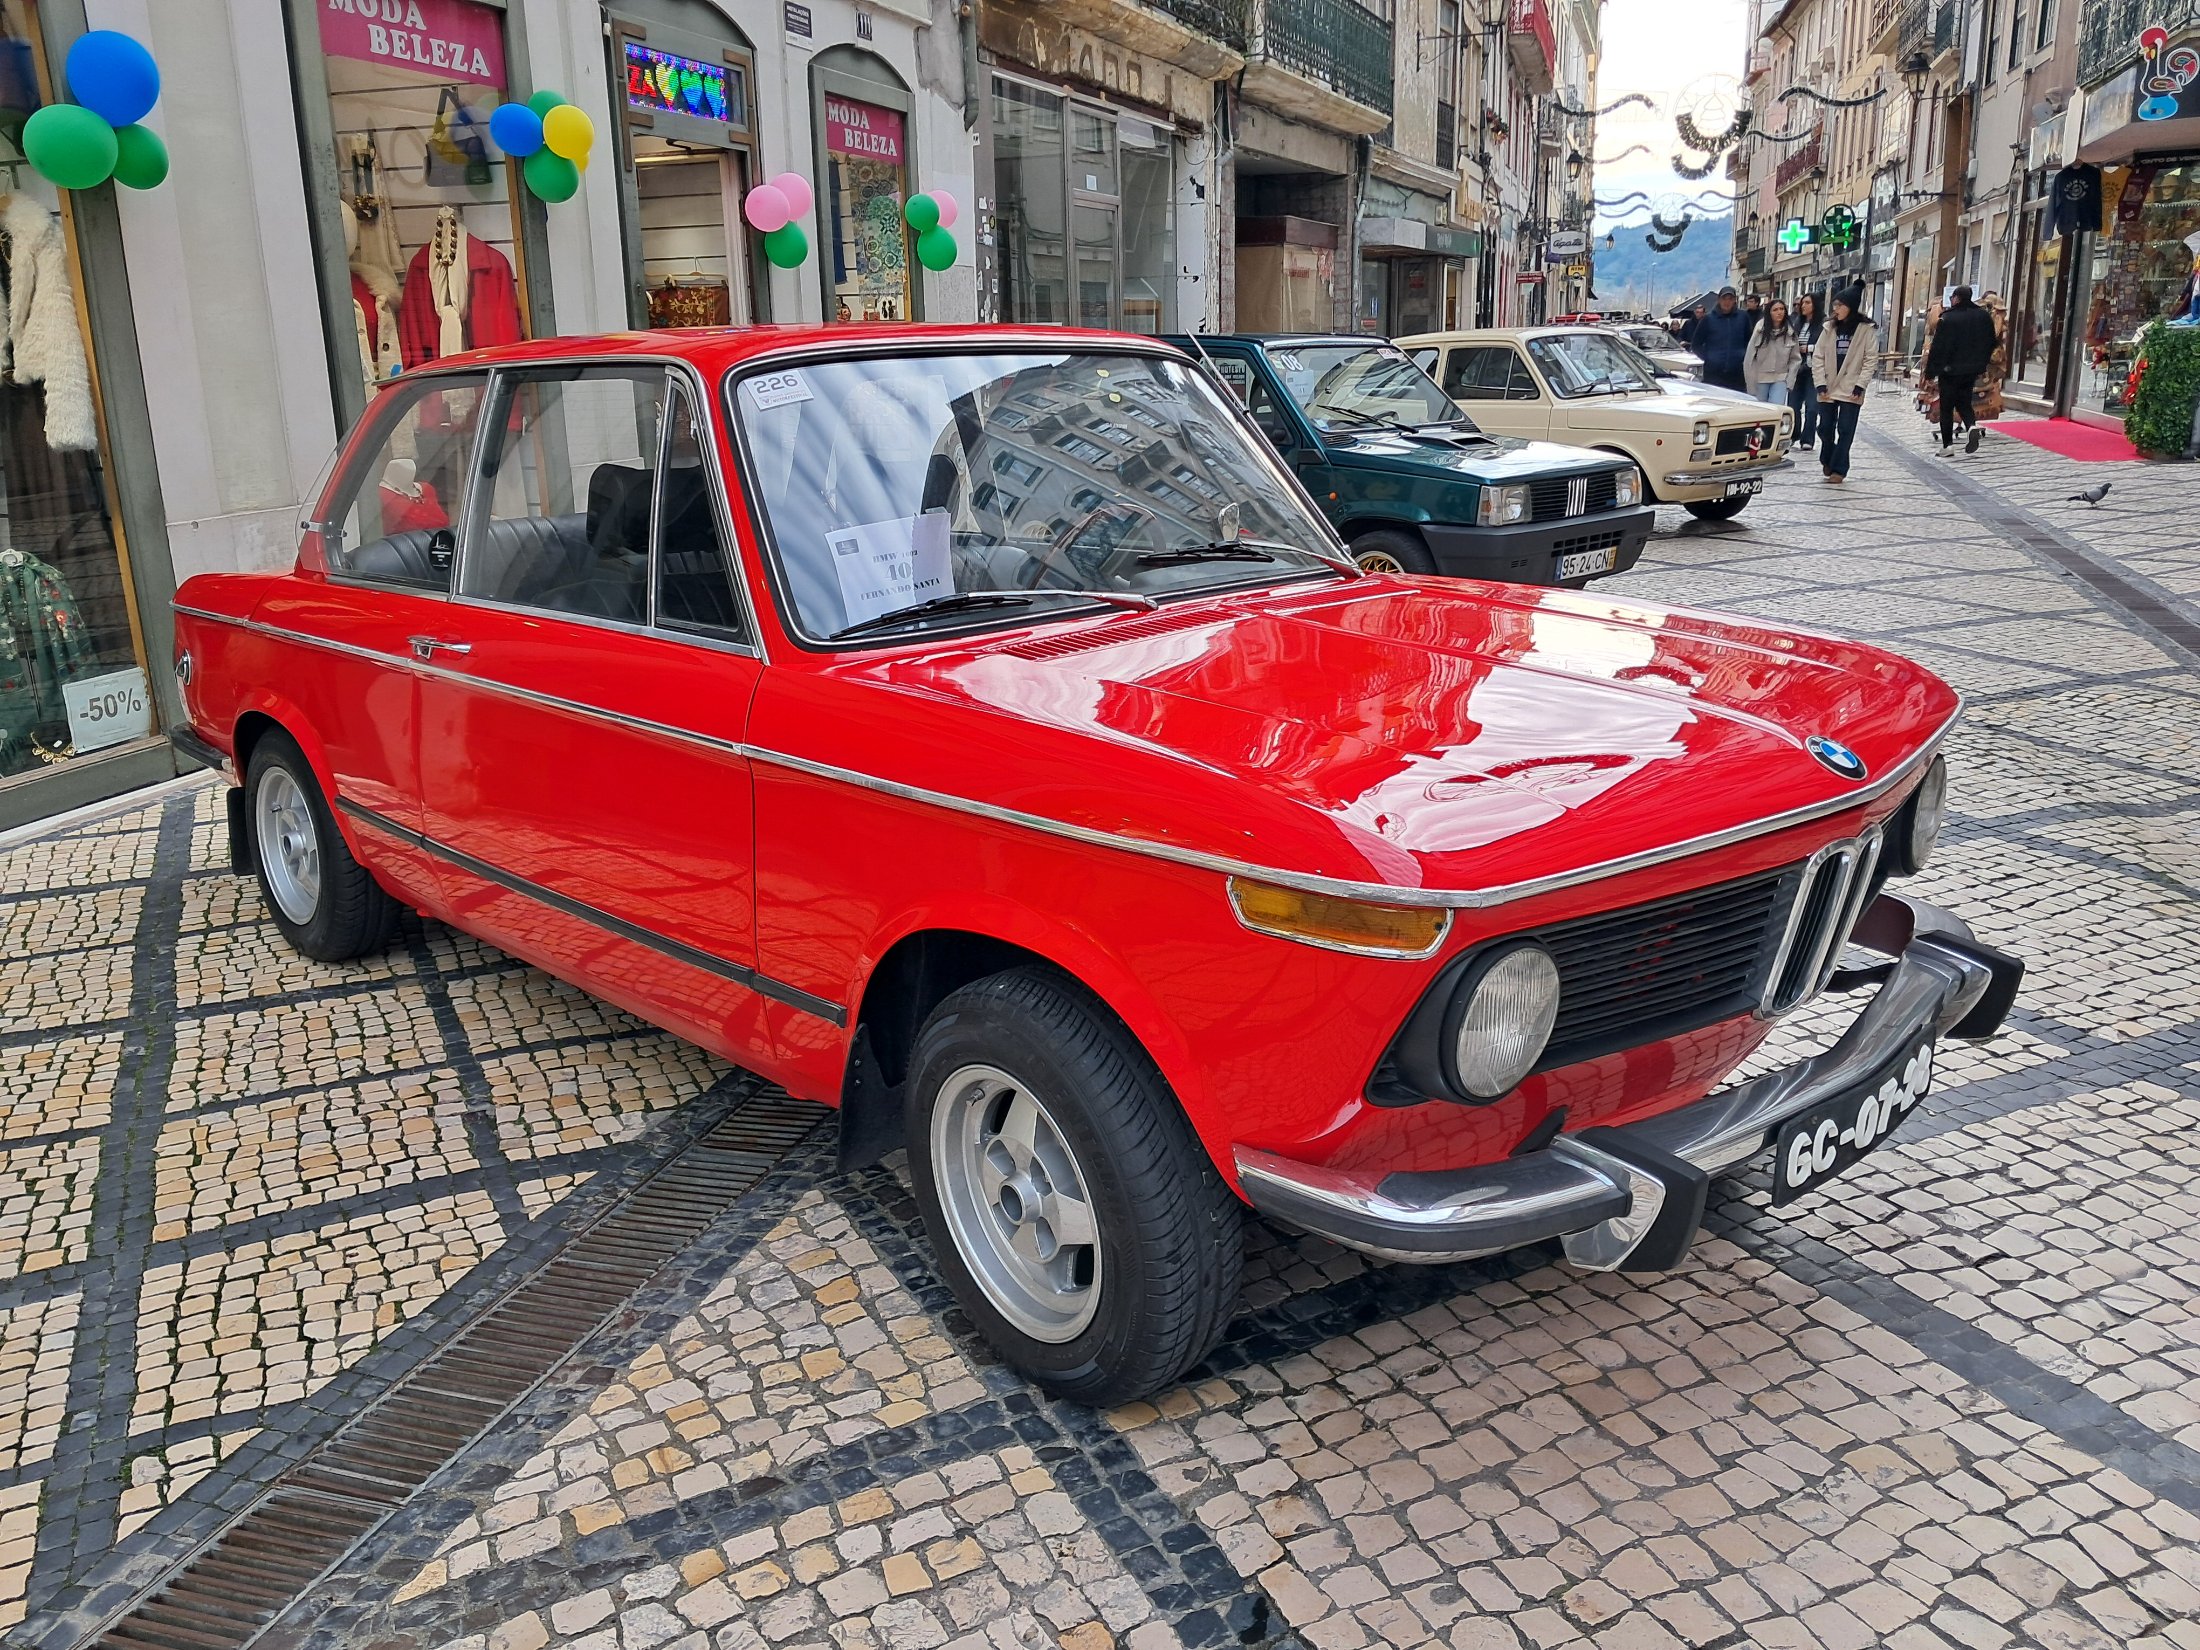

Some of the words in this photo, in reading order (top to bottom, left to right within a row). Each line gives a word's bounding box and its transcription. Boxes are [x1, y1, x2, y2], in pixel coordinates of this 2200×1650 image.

[328, 0, 427, 30] MODA
[367, 24, 491, 77] BELEZA
[827, 101, 870, 130] MODA
[844, 127, 898, 157] BELEZA
[1281, 354, 1304, 371] 08
[753, 374, 798, 394] 226
[873, 551, 898, 564] BMW
[860, 584, 912, 601] FERNANDO
[913, 577, 941, 591] SANTA
[80, 687, 141, 722] -50%
[1786, 1043, 1932, 1188] GC-07-28
